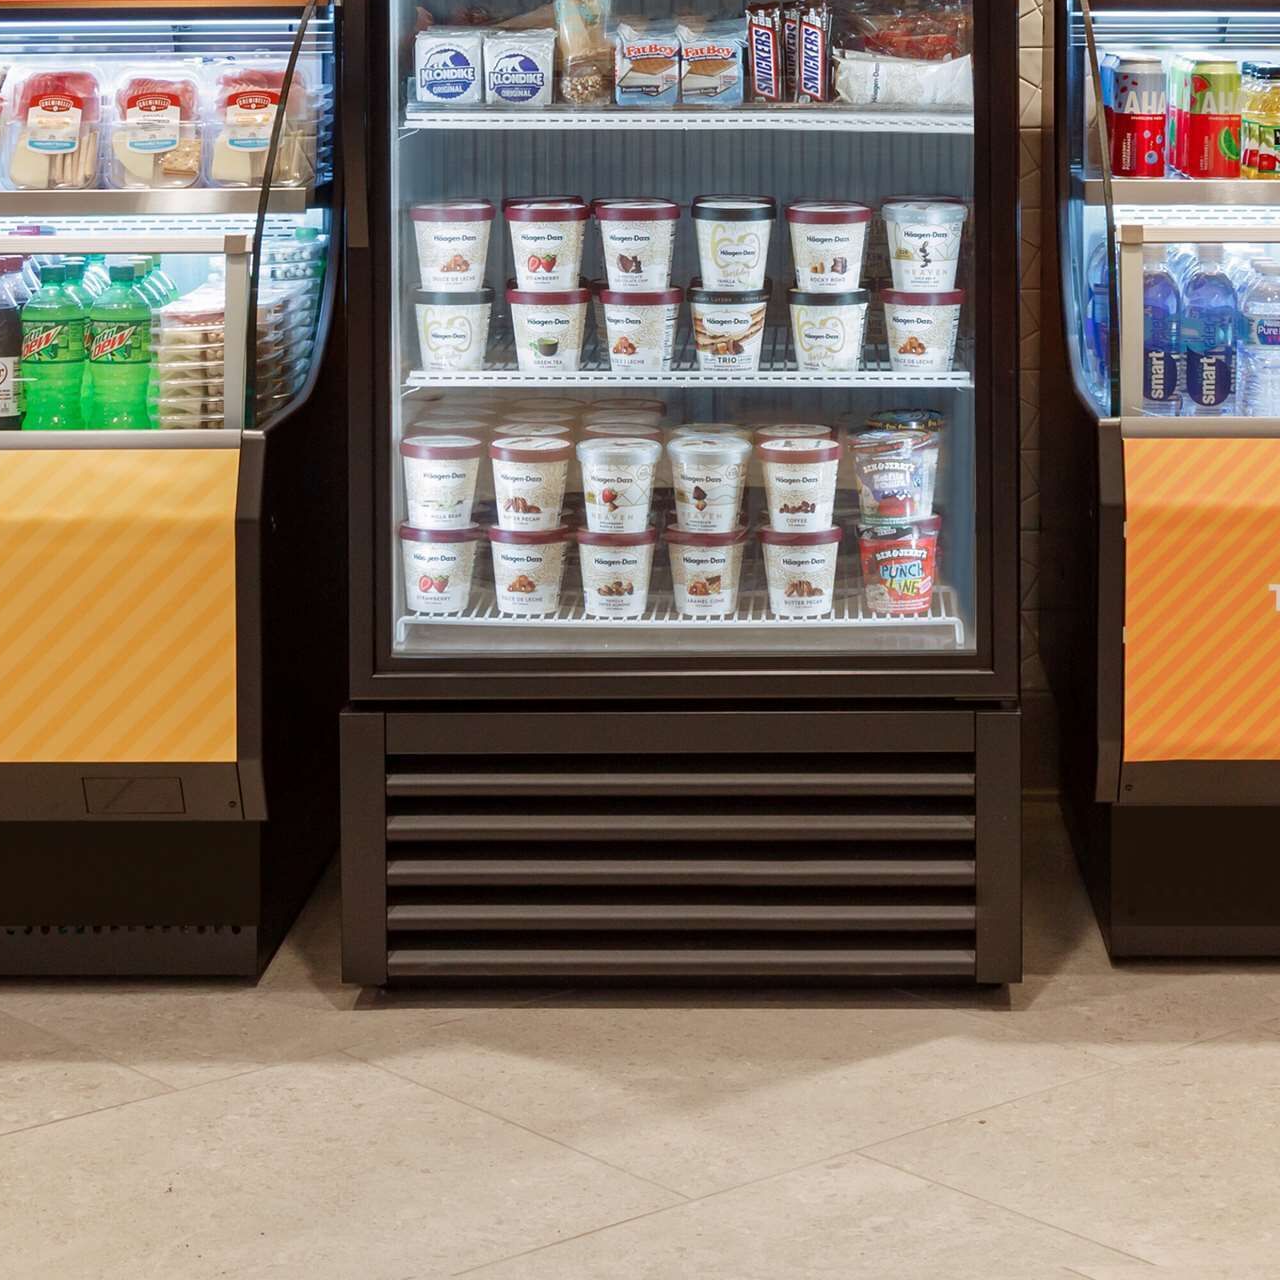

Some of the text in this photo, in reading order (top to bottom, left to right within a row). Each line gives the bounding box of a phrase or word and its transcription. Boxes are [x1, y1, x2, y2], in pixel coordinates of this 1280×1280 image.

[626, 43, 676, 58] FatBoy
[683, 45, 733, 59] FatBoy
[754, 28, 774, 94] SNICKERS
[803, 27, 821, 95] SNICKERS
[421, 67, 475, 86] KLONDIKE
[490, 72, 544, 91] KLONDIKE
[432, 84, 464, 93] ORIGINAL
[501, 89, 532, 98] ORIGINAL
[1124, 92, 1166, 113] AHA
[1258, 326, 1278, 336] Pure
[717, 356, 737, 364] TRIO
[1148, 351, 1165, 400] smart
[1200, 356, 1216, 405] smart
[881, 564, 924, 579] PUNCH
